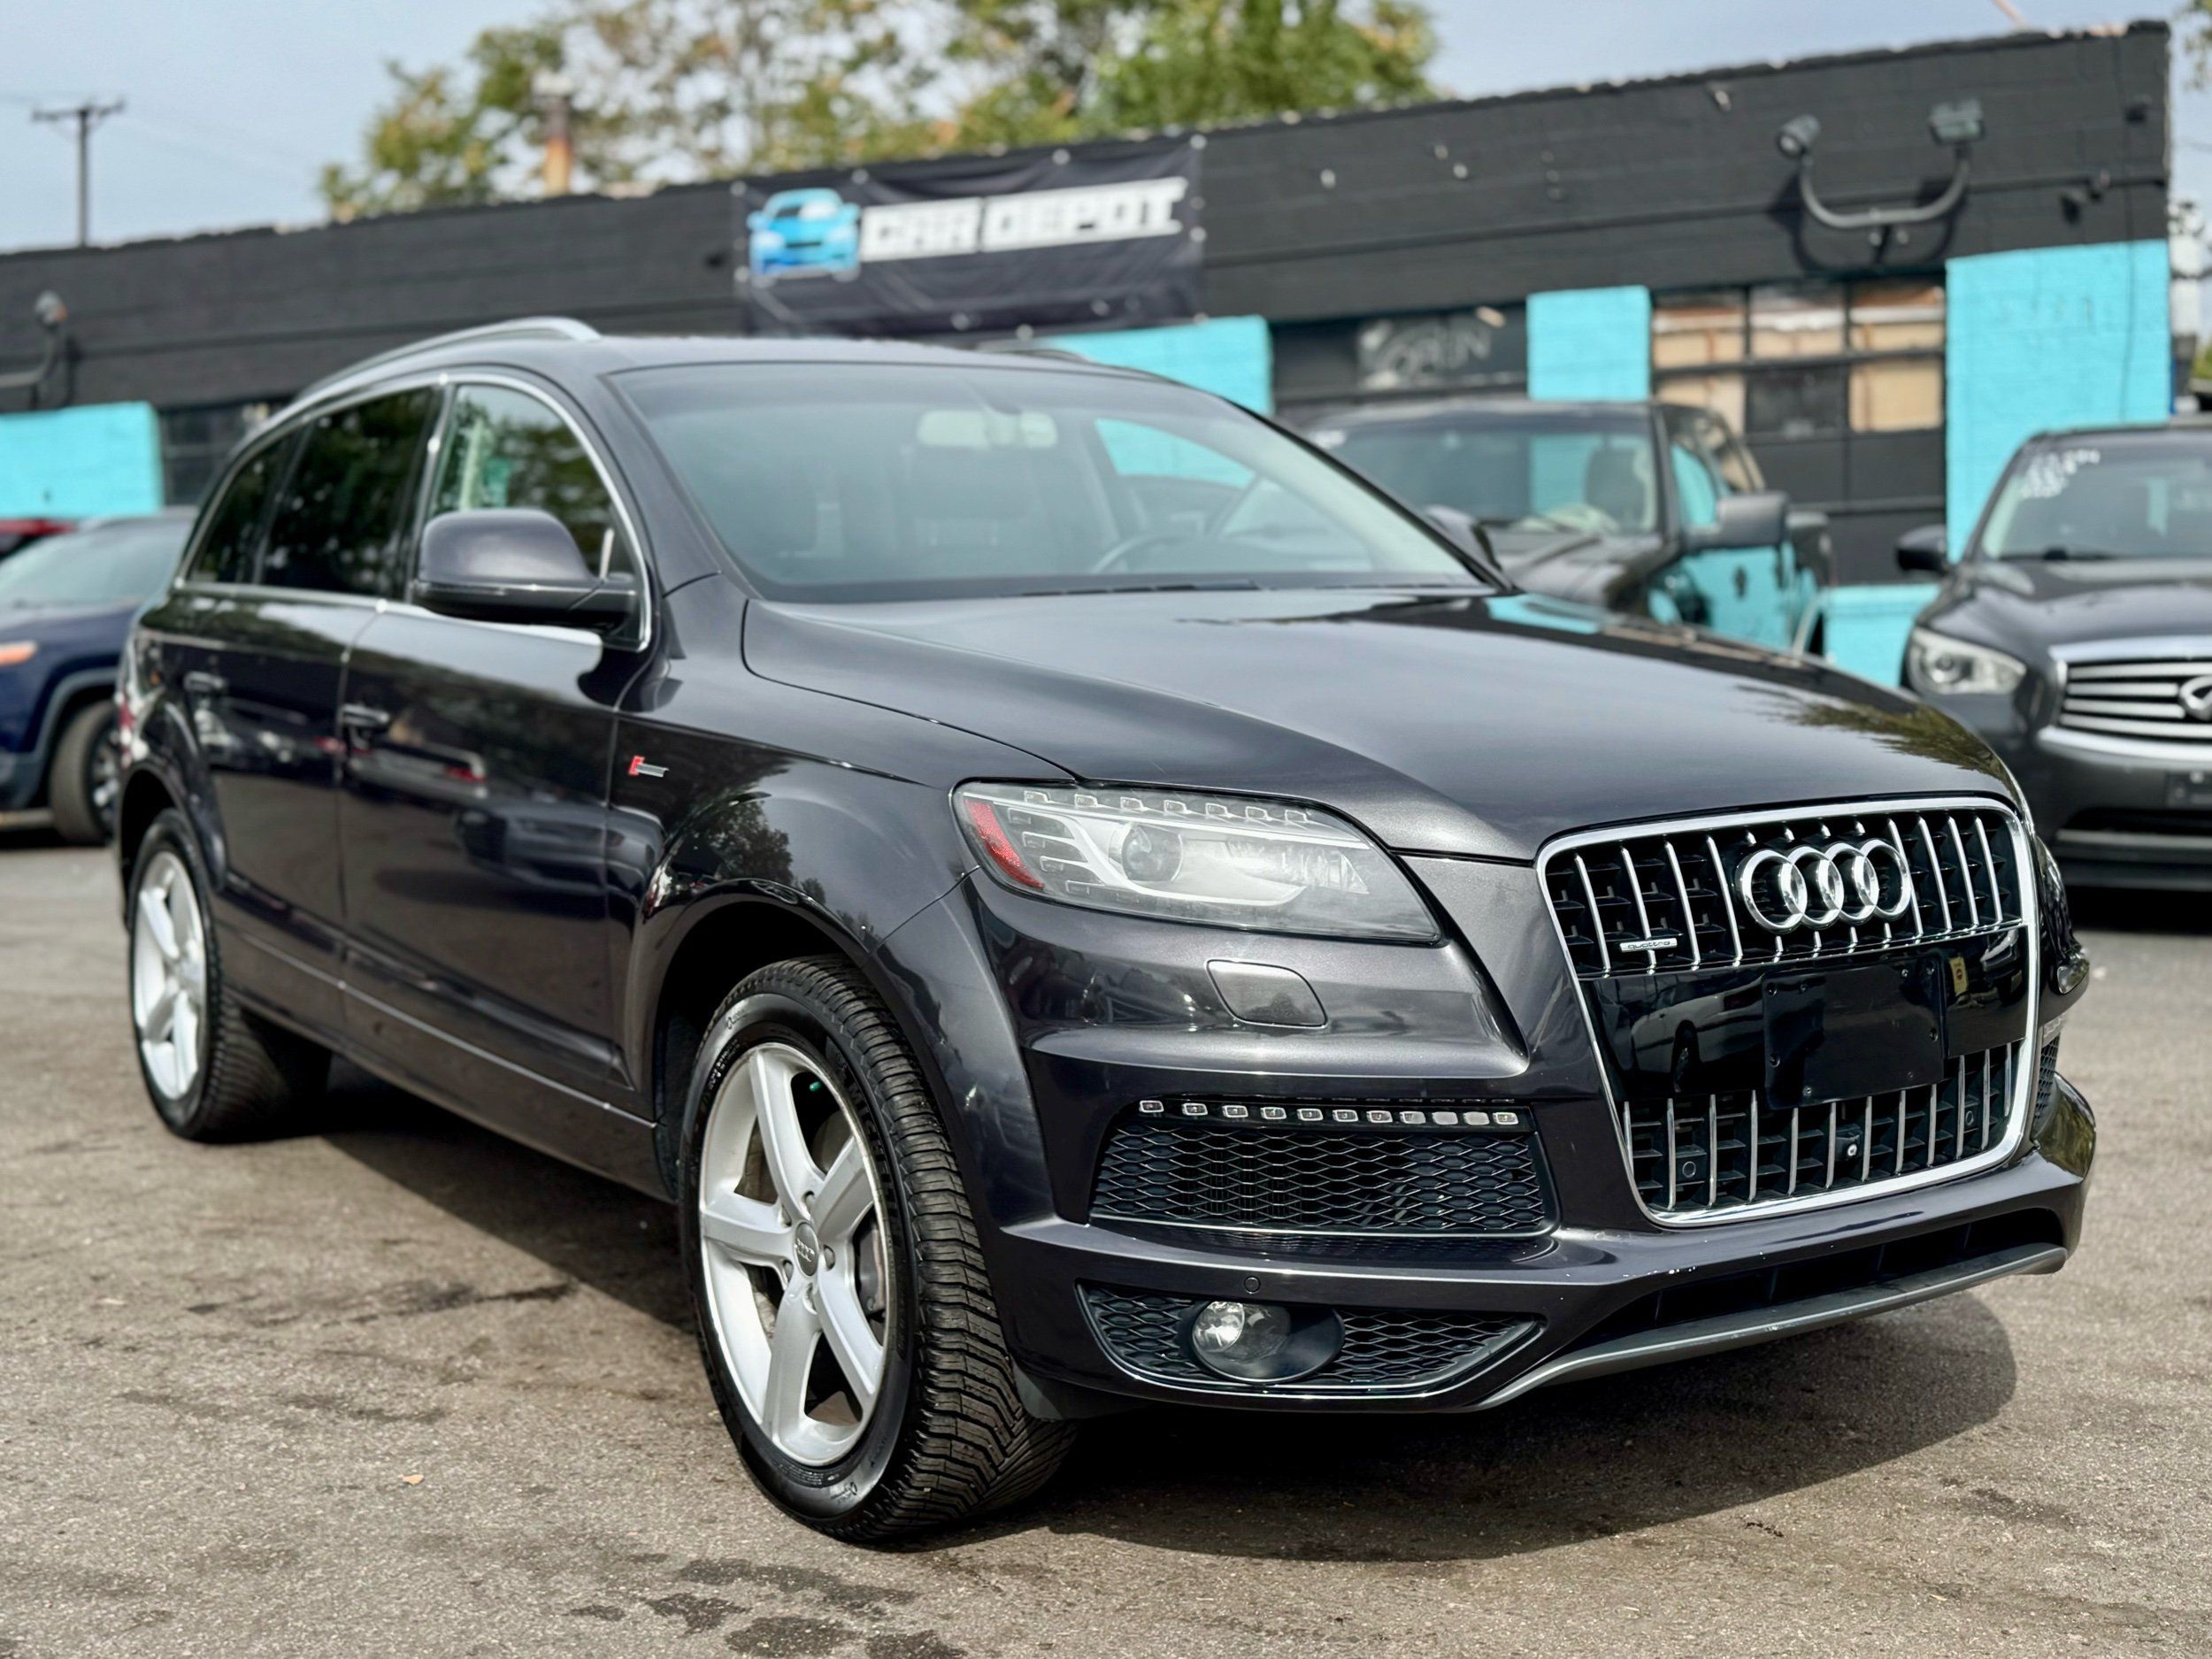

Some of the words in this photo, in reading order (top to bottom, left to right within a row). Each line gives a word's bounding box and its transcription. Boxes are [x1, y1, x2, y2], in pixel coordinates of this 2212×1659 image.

[861, 198, 981, 262] CAR
[983, 177, 1188, 251] DEPOT
[1627, 941, 1671, 950] quattro
